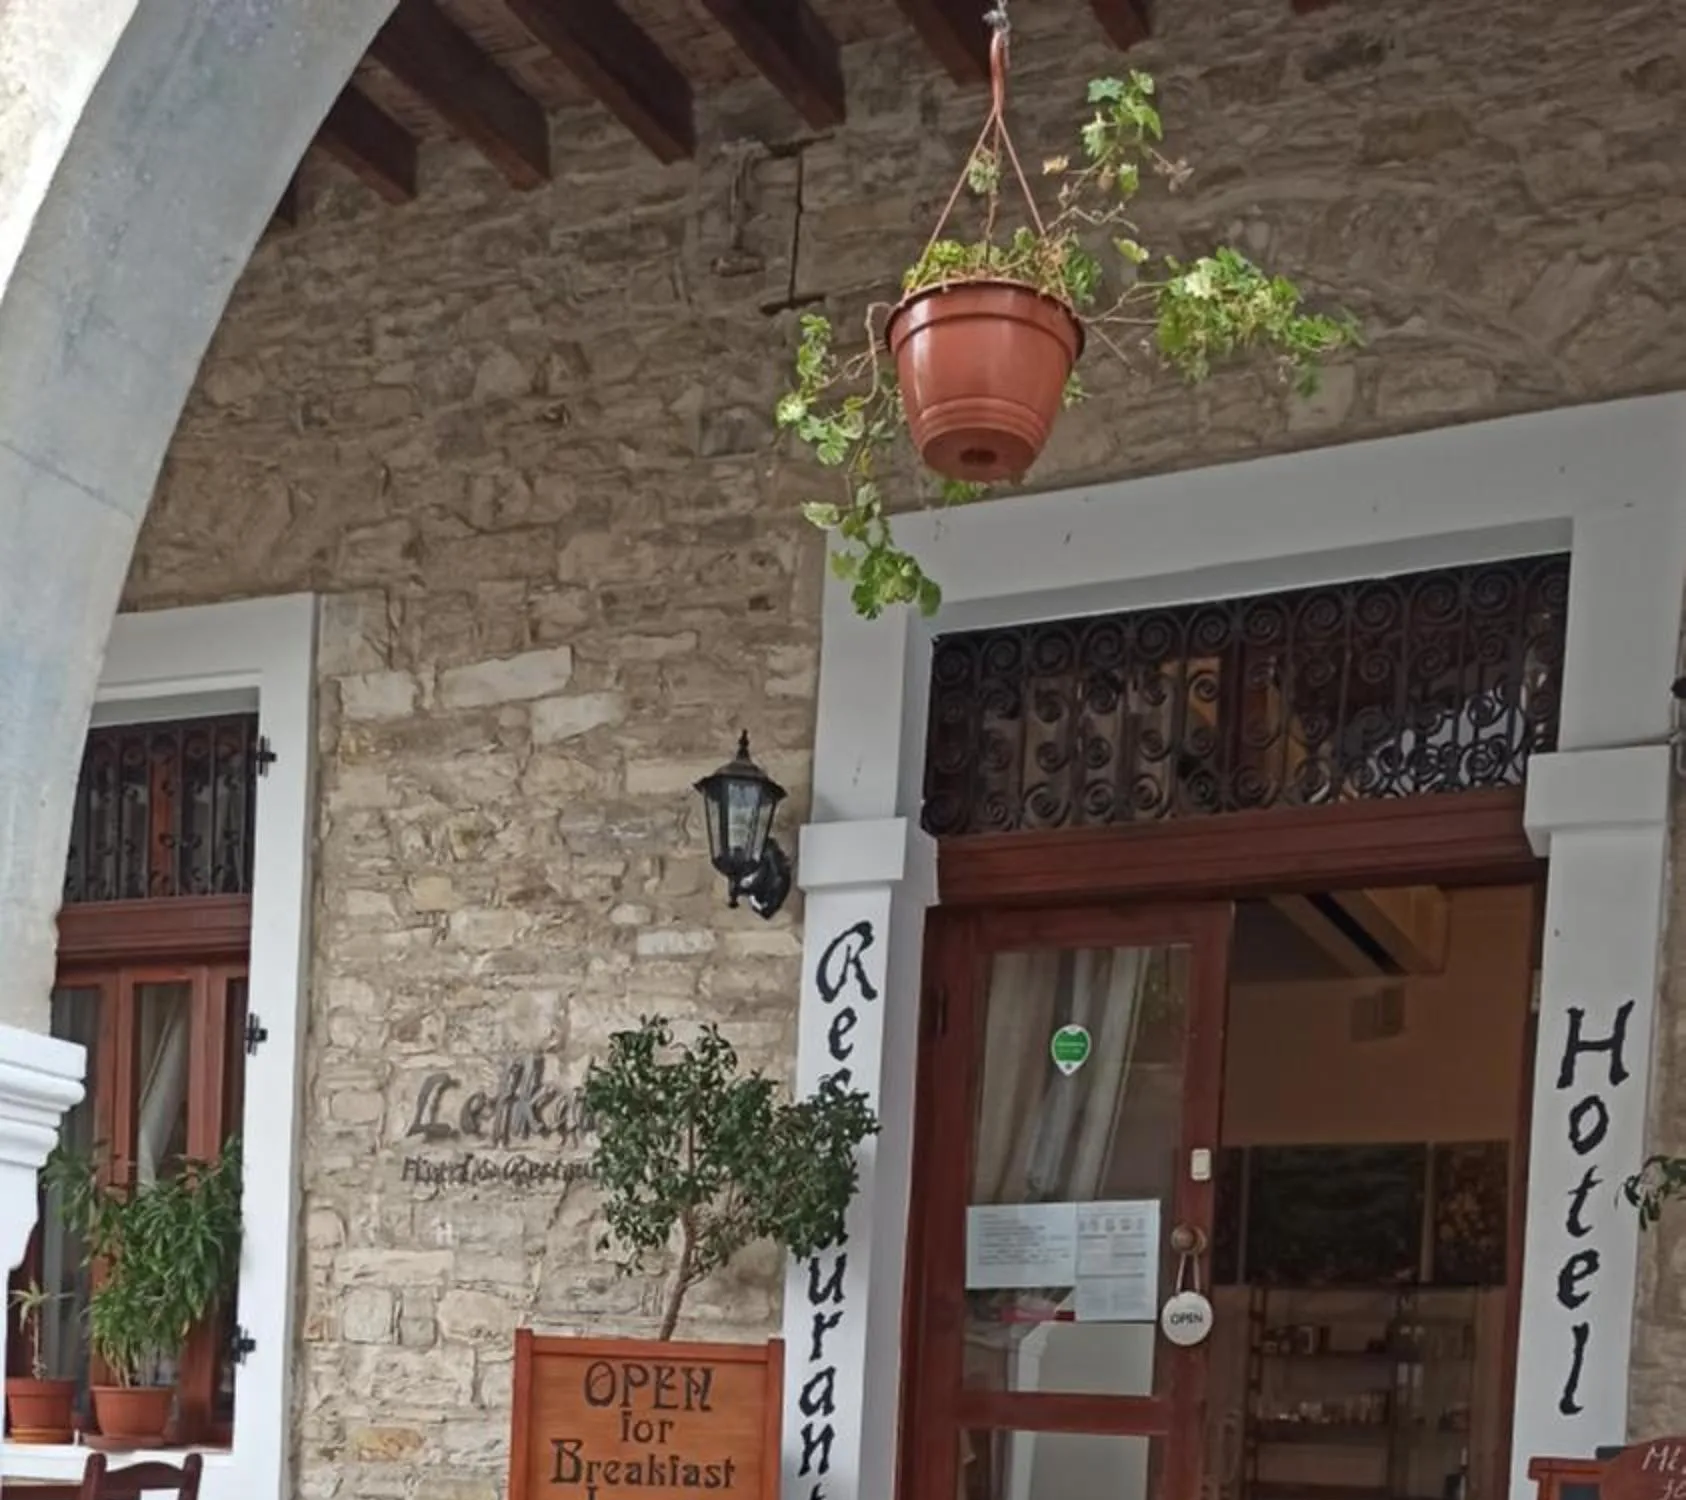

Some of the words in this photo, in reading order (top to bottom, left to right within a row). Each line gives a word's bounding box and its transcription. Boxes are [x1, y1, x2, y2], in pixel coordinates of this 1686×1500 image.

[1556, 1000, 1636, 1416] Hotel
[1170, 1311, 1204, 1326] OPEN
[584, 1360, 715, 1412] OPEN
[620, 1410, 675, 1444] for
[549, 1438, 736, 1489] Breakfast
